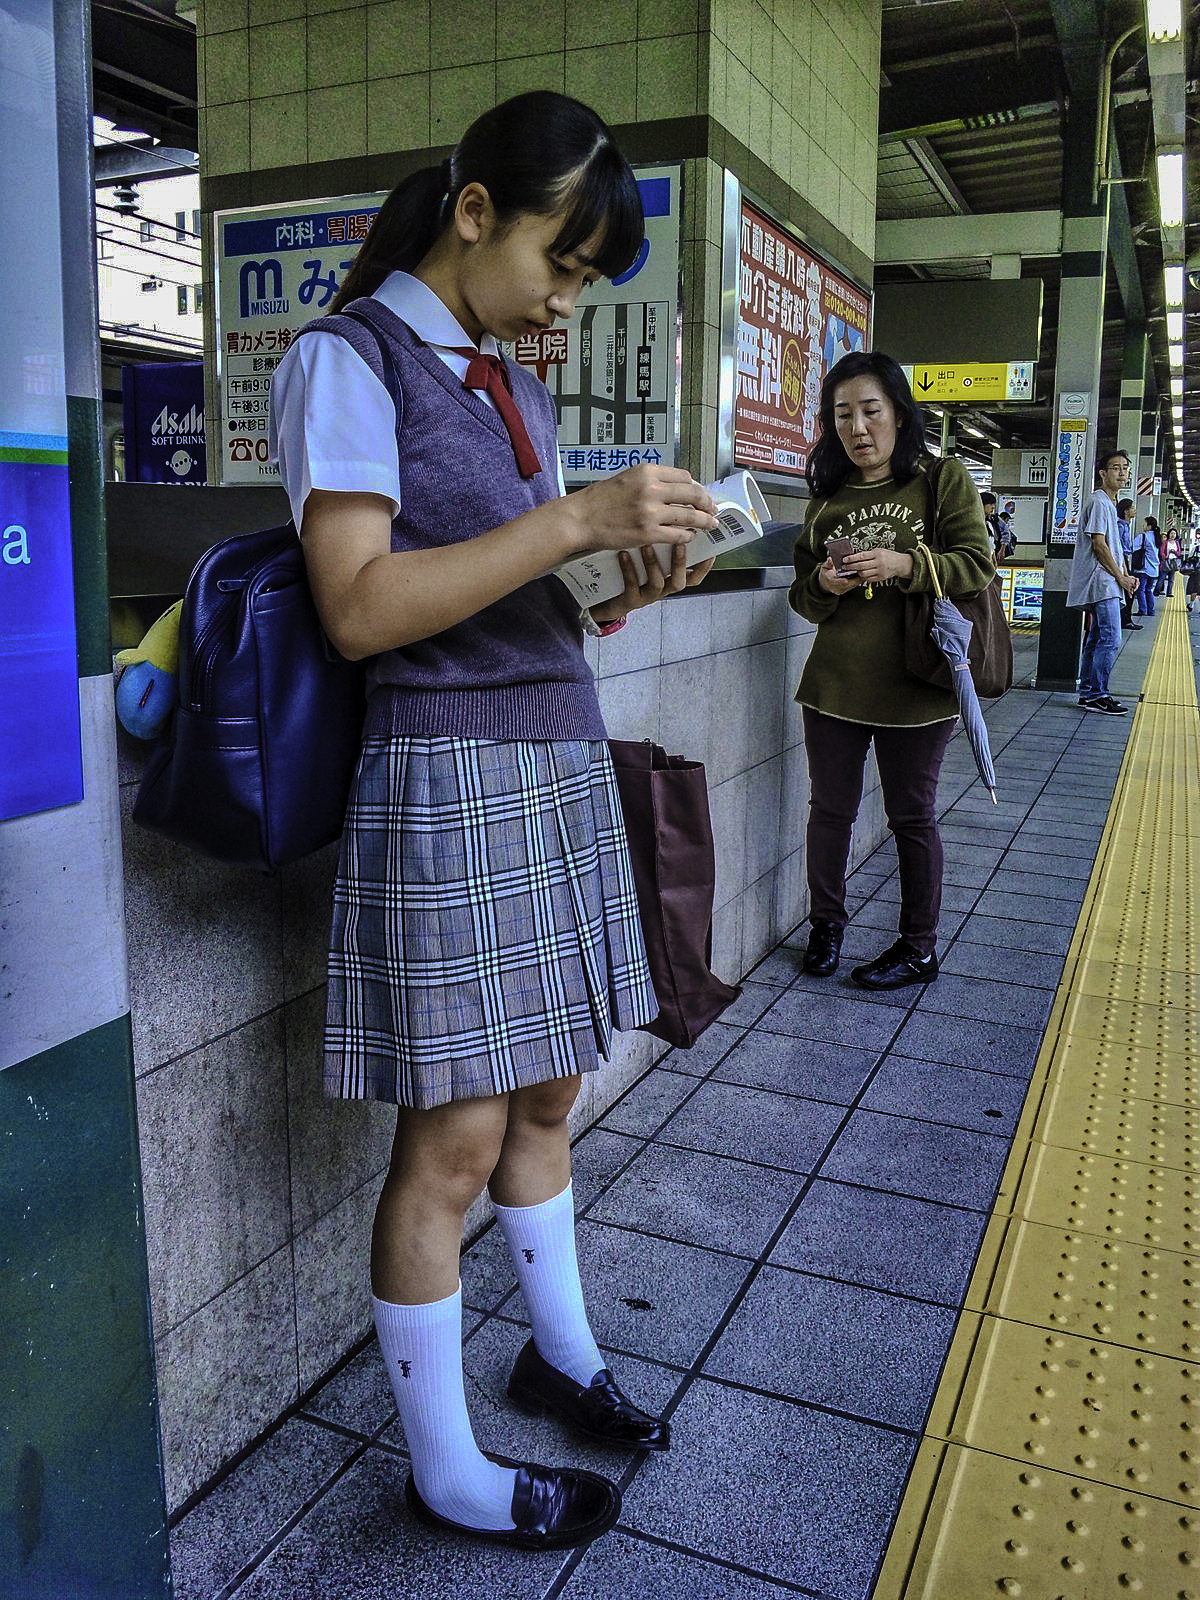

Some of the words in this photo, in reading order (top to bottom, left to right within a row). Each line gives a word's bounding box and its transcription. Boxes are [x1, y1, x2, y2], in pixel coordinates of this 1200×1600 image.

[251, 299, 290, 316] MISUZU
[227, 327, 301, 354] 胃カメラ検
[518, 332, 567, 361] 当院
[582, 329, 591, 367] 目白通り
[616, 328, 626, 366] 千川通り
[605, 335, 614, 386] 三井住友銀行
[639, 352, 650, 391] 練馬駅
[736, 319, 782, 409] 無料
[938, 371, 955, 379] 出口
[151, 404, 206, 436] Asah
[152, 436, 174, 446] SOFT
